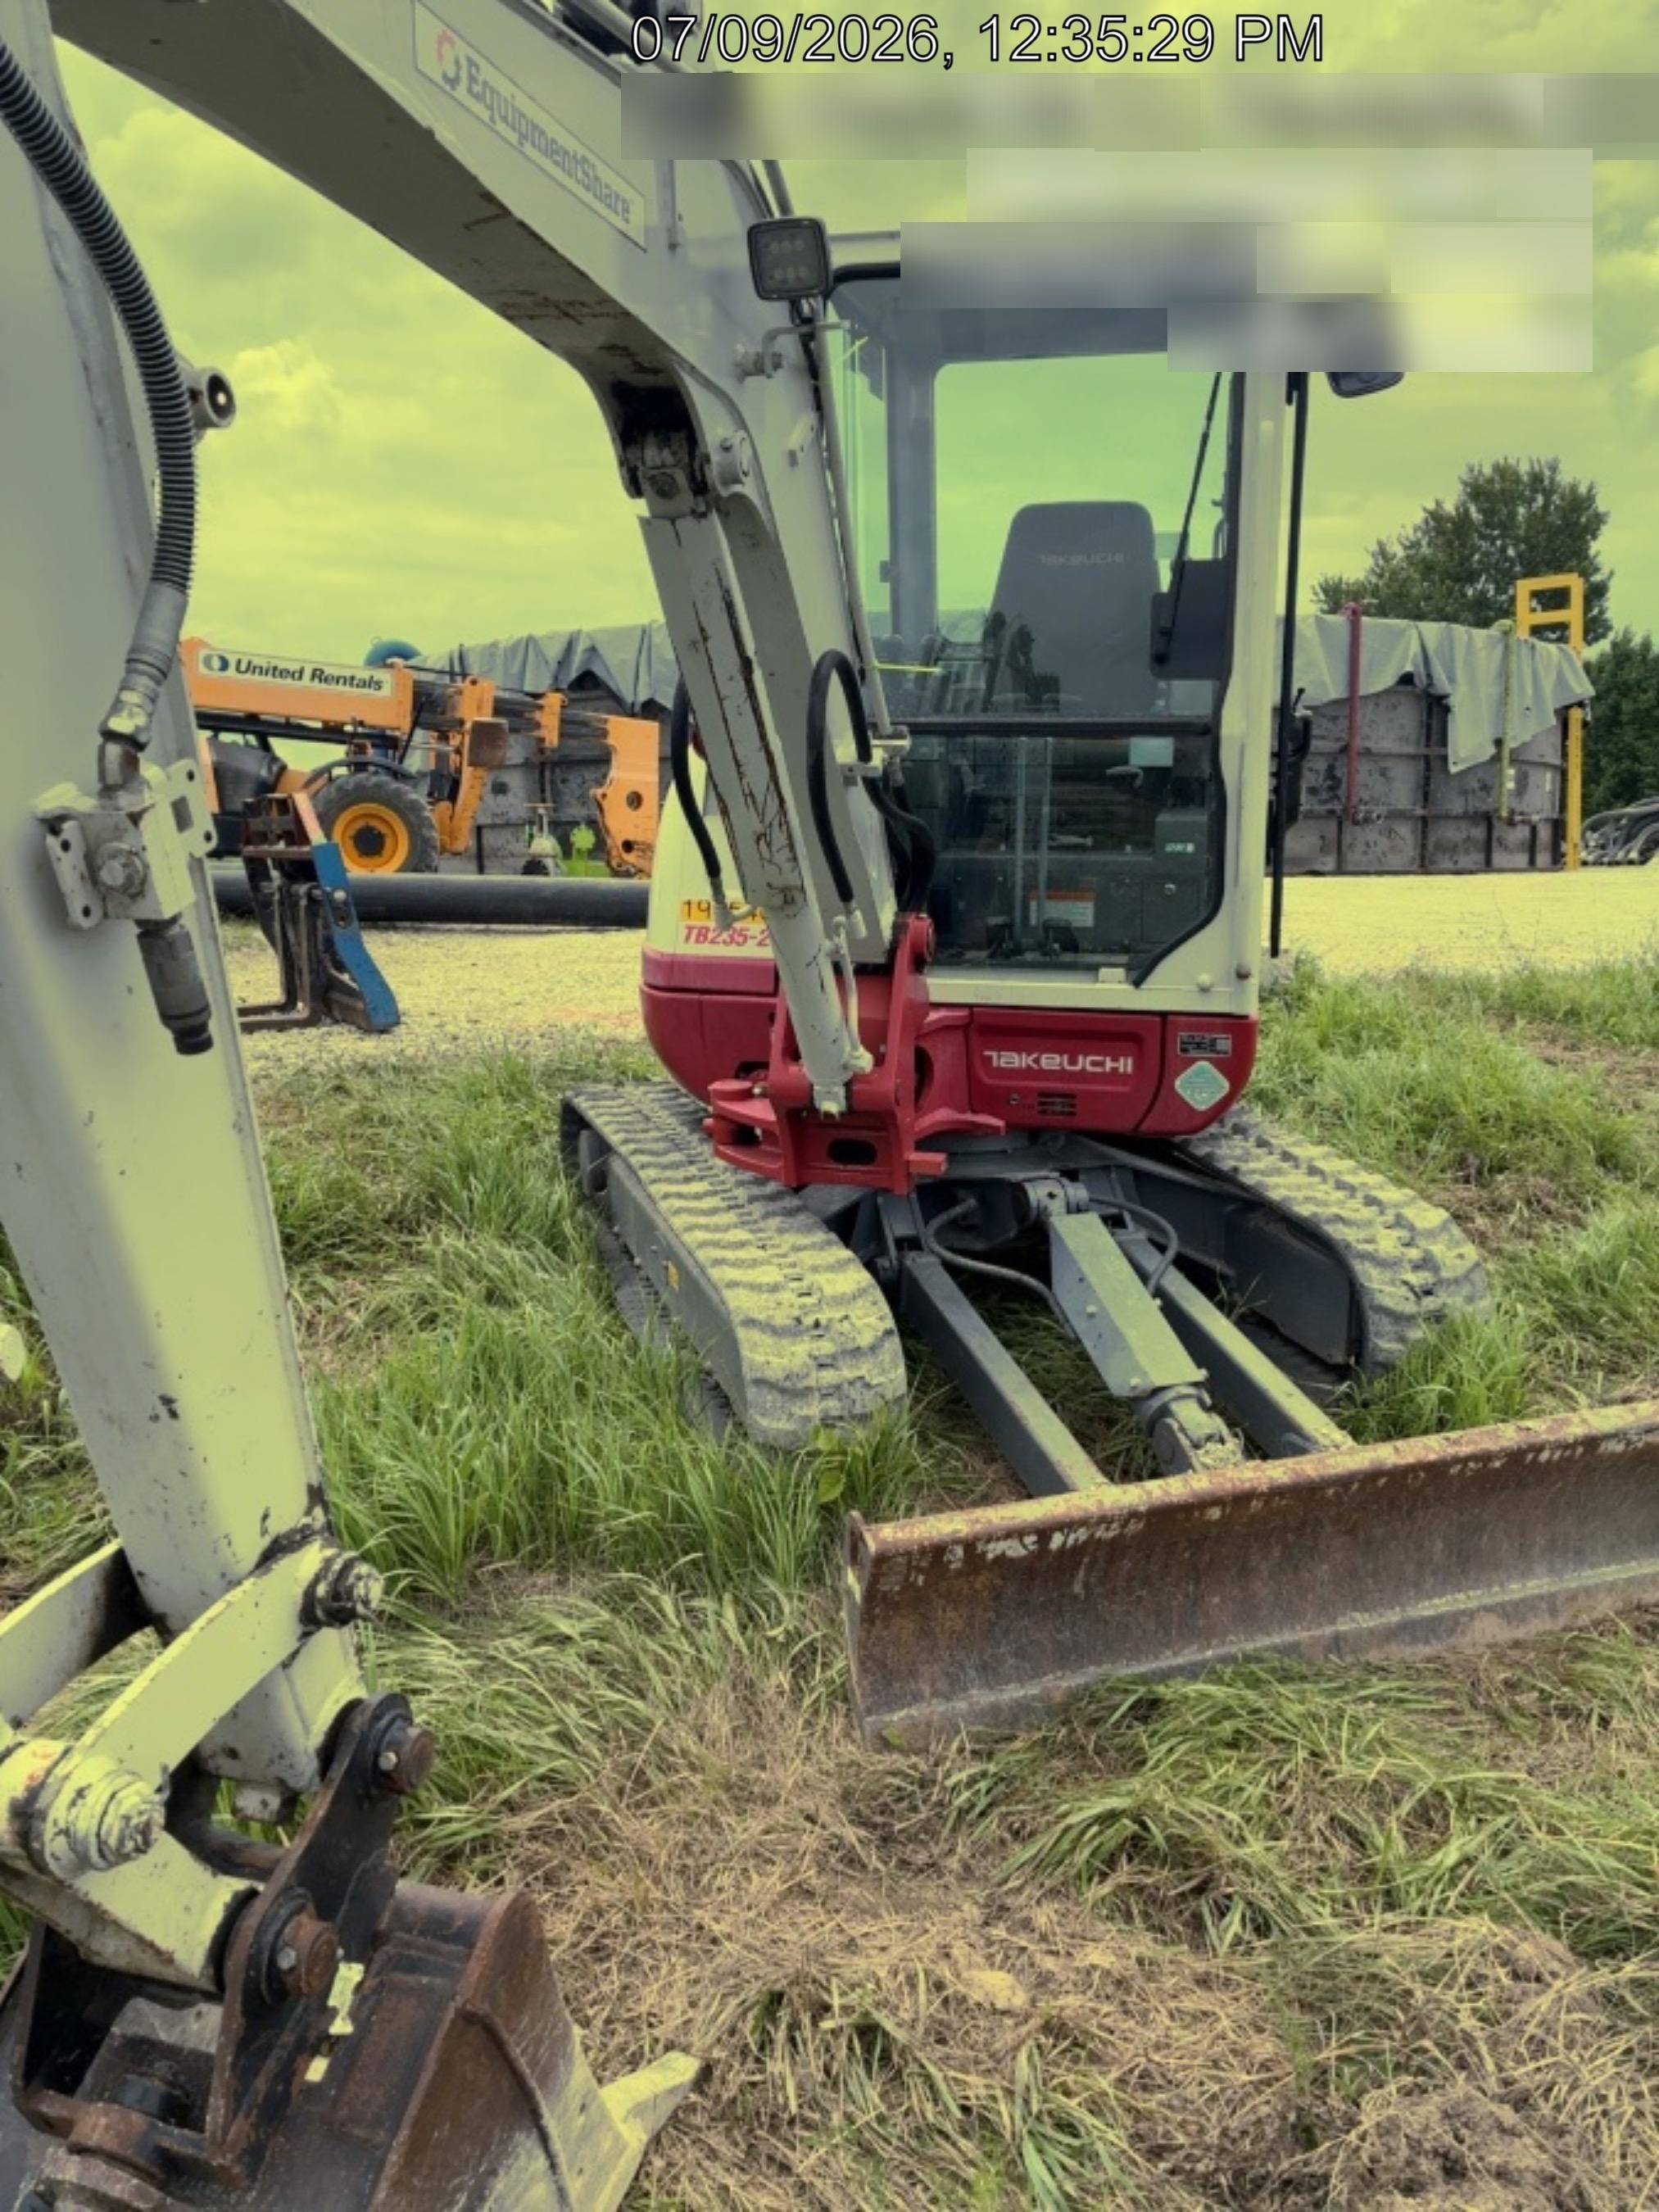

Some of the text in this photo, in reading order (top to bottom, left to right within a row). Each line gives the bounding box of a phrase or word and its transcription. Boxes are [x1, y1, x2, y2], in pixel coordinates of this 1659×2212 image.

[466, 55, 630, 224] EquipmentShare
[235, 658, 383, 691] United Rentals
